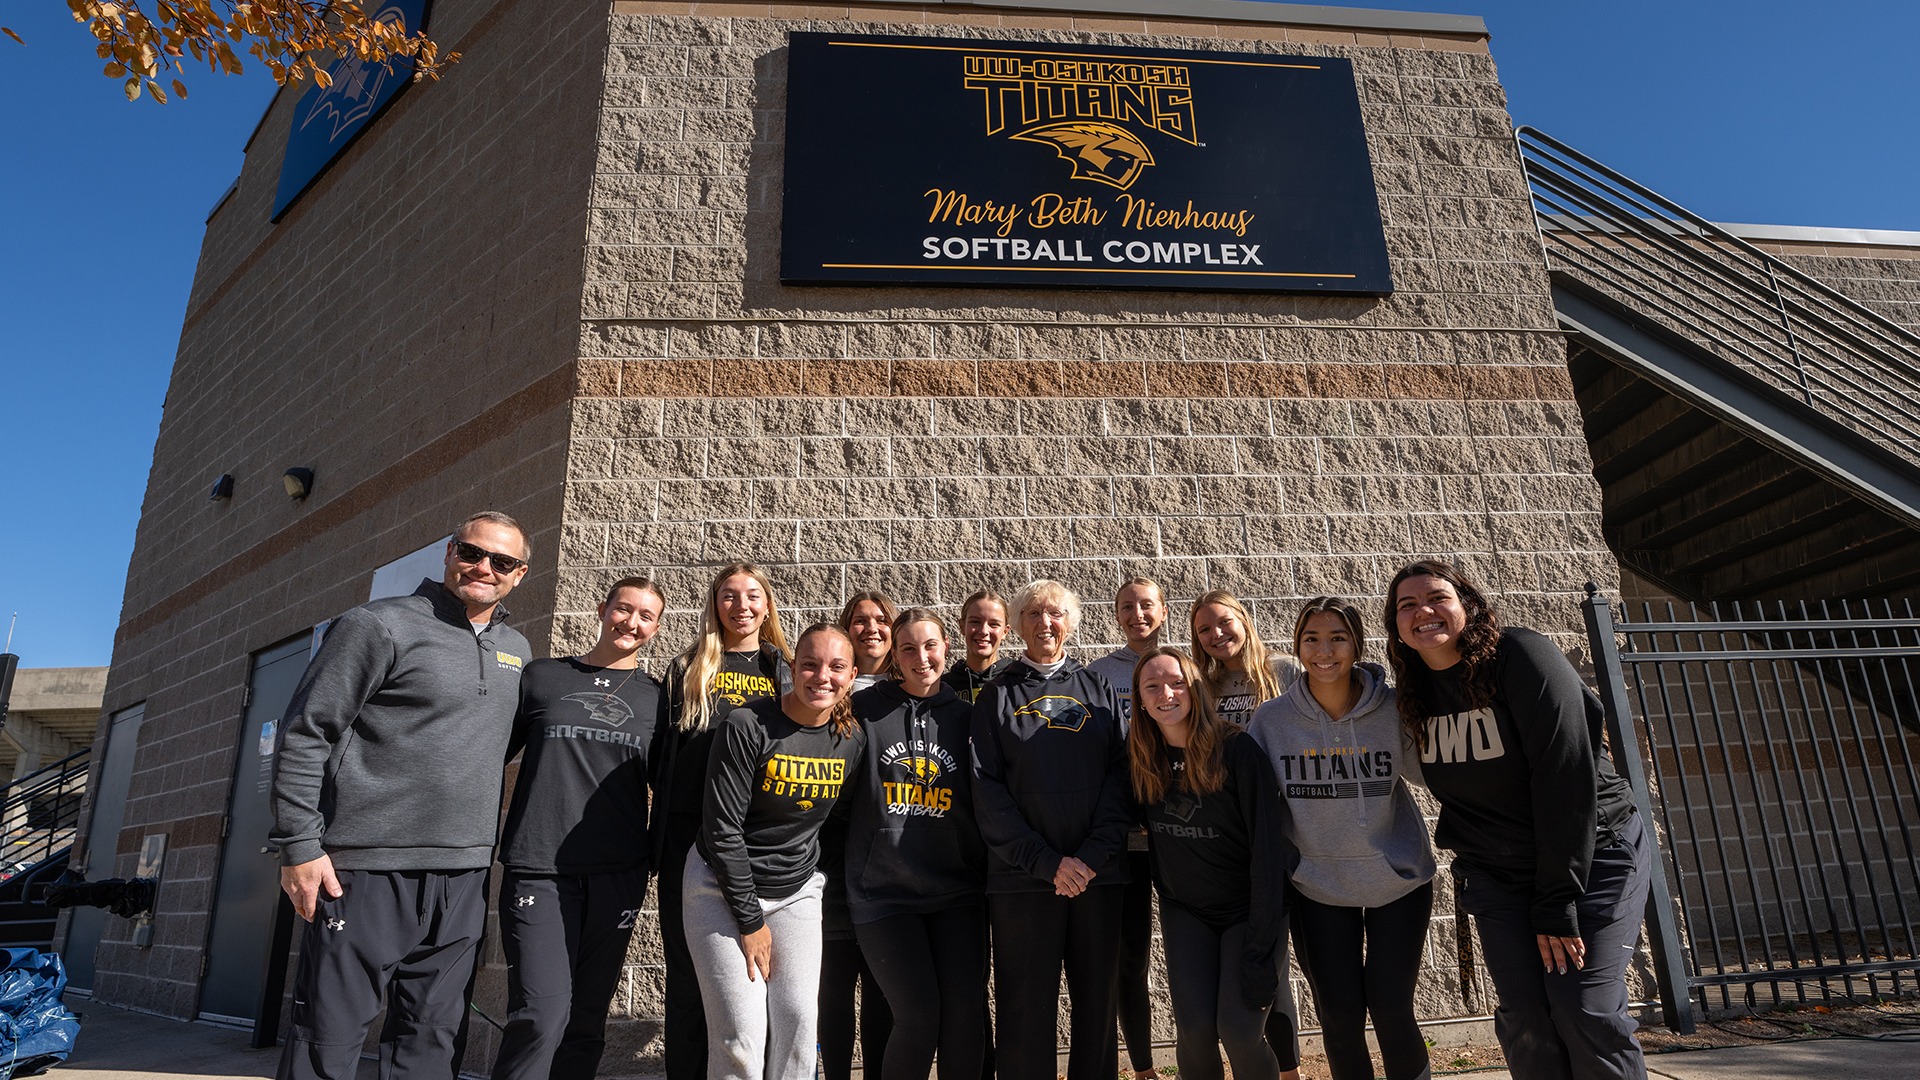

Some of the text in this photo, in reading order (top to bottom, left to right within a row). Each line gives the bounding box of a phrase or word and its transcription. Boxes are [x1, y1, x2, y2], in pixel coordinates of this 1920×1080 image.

[964, 56, 1190, 87] UW-OSHKOSH
[964, 77, 1198, 146] TITANS
[924, 188, 1255, 237] Mary Beth Nienhaus
[922, 236, 1264, 266] SOFTBALL COMPLEX
[496, 650, 523, 668] UWO
[543, 724, 642, 750] SOFTBALL
[1420, 706, 1505, 764] UWO
[880, 741, 907, 766] UWO
[1280, 750, 1392, 781] TITANS
[773, 757, 843, 781] TITANS
[883, 781, 953, 811] TITANS
[1290, 786, 1334, 797] SOFTBALL
[887, 801, 945, 818] SOFTBALL
